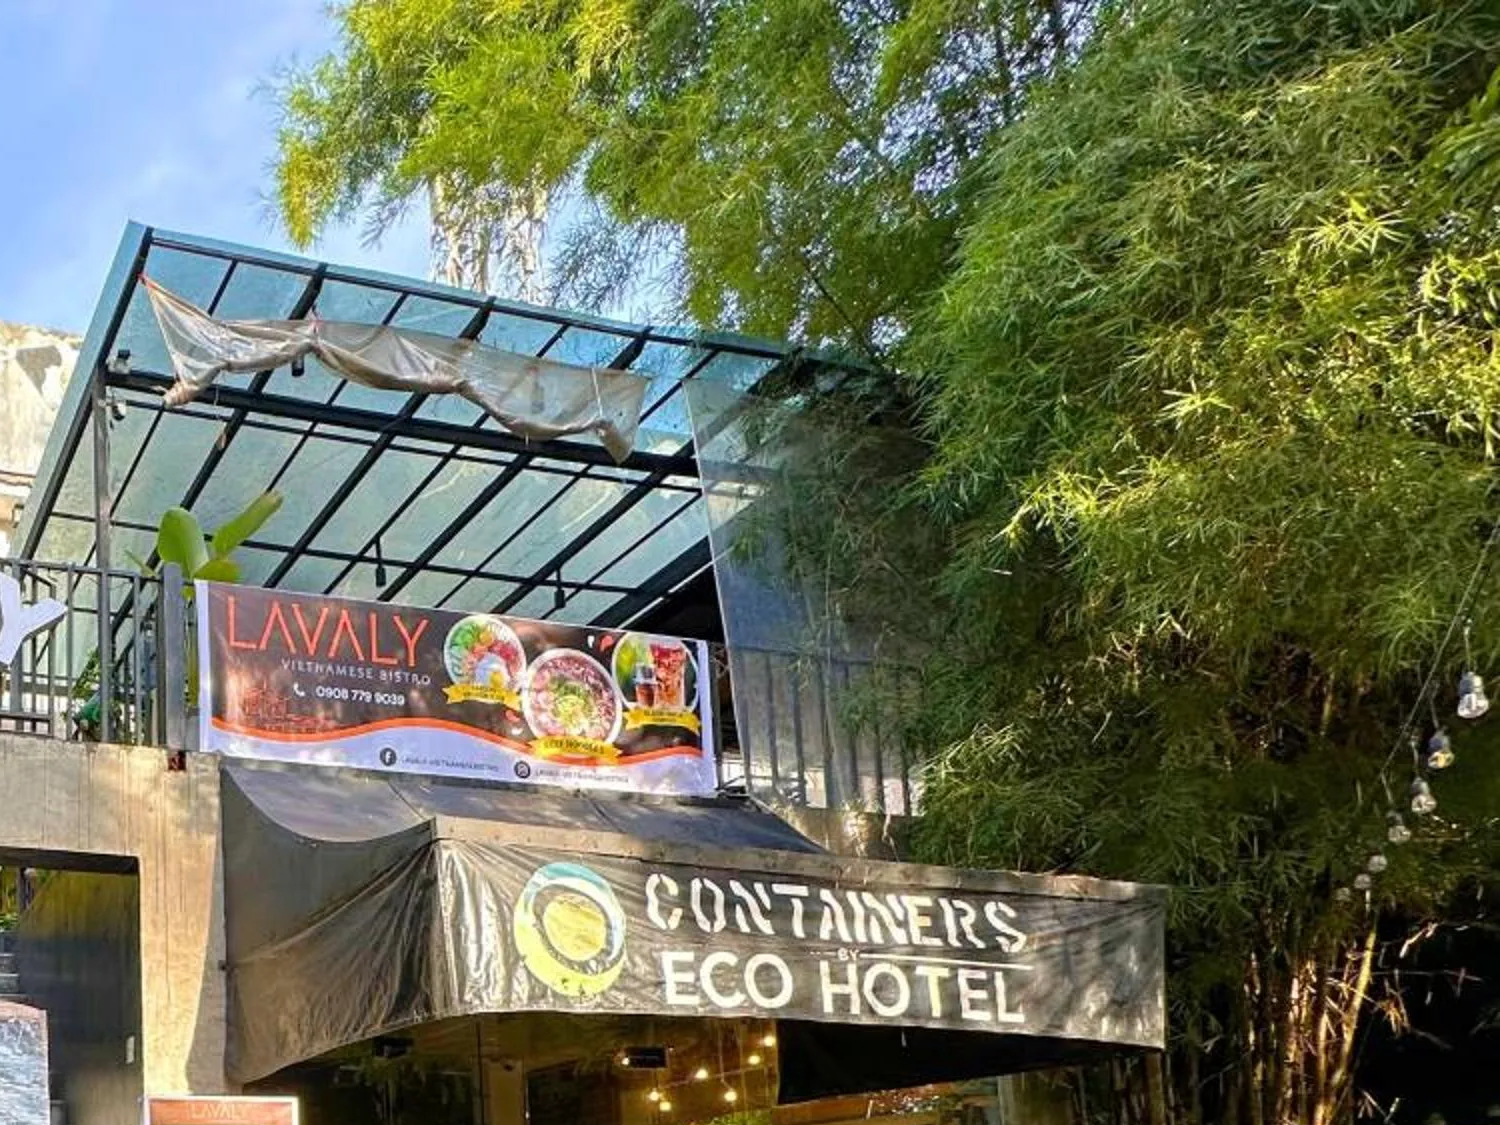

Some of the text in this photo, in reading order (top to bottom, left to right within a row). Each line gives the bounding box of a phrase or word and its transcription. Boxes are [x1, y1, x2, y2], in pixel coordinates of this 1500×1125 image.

[226, 595, 429, 668] LAVALY
[280, 657, 432, 687] VIETNAMESE BISTRO
[315, 685, 349, 700] 0908
[644, 872, 1028, 954] CONTAINERS
[837, 948, 860, 961] BY
[659, 950, 1026, 1024] ECO HOTEL
[190, 1102, 250, 1120] LAVALY
